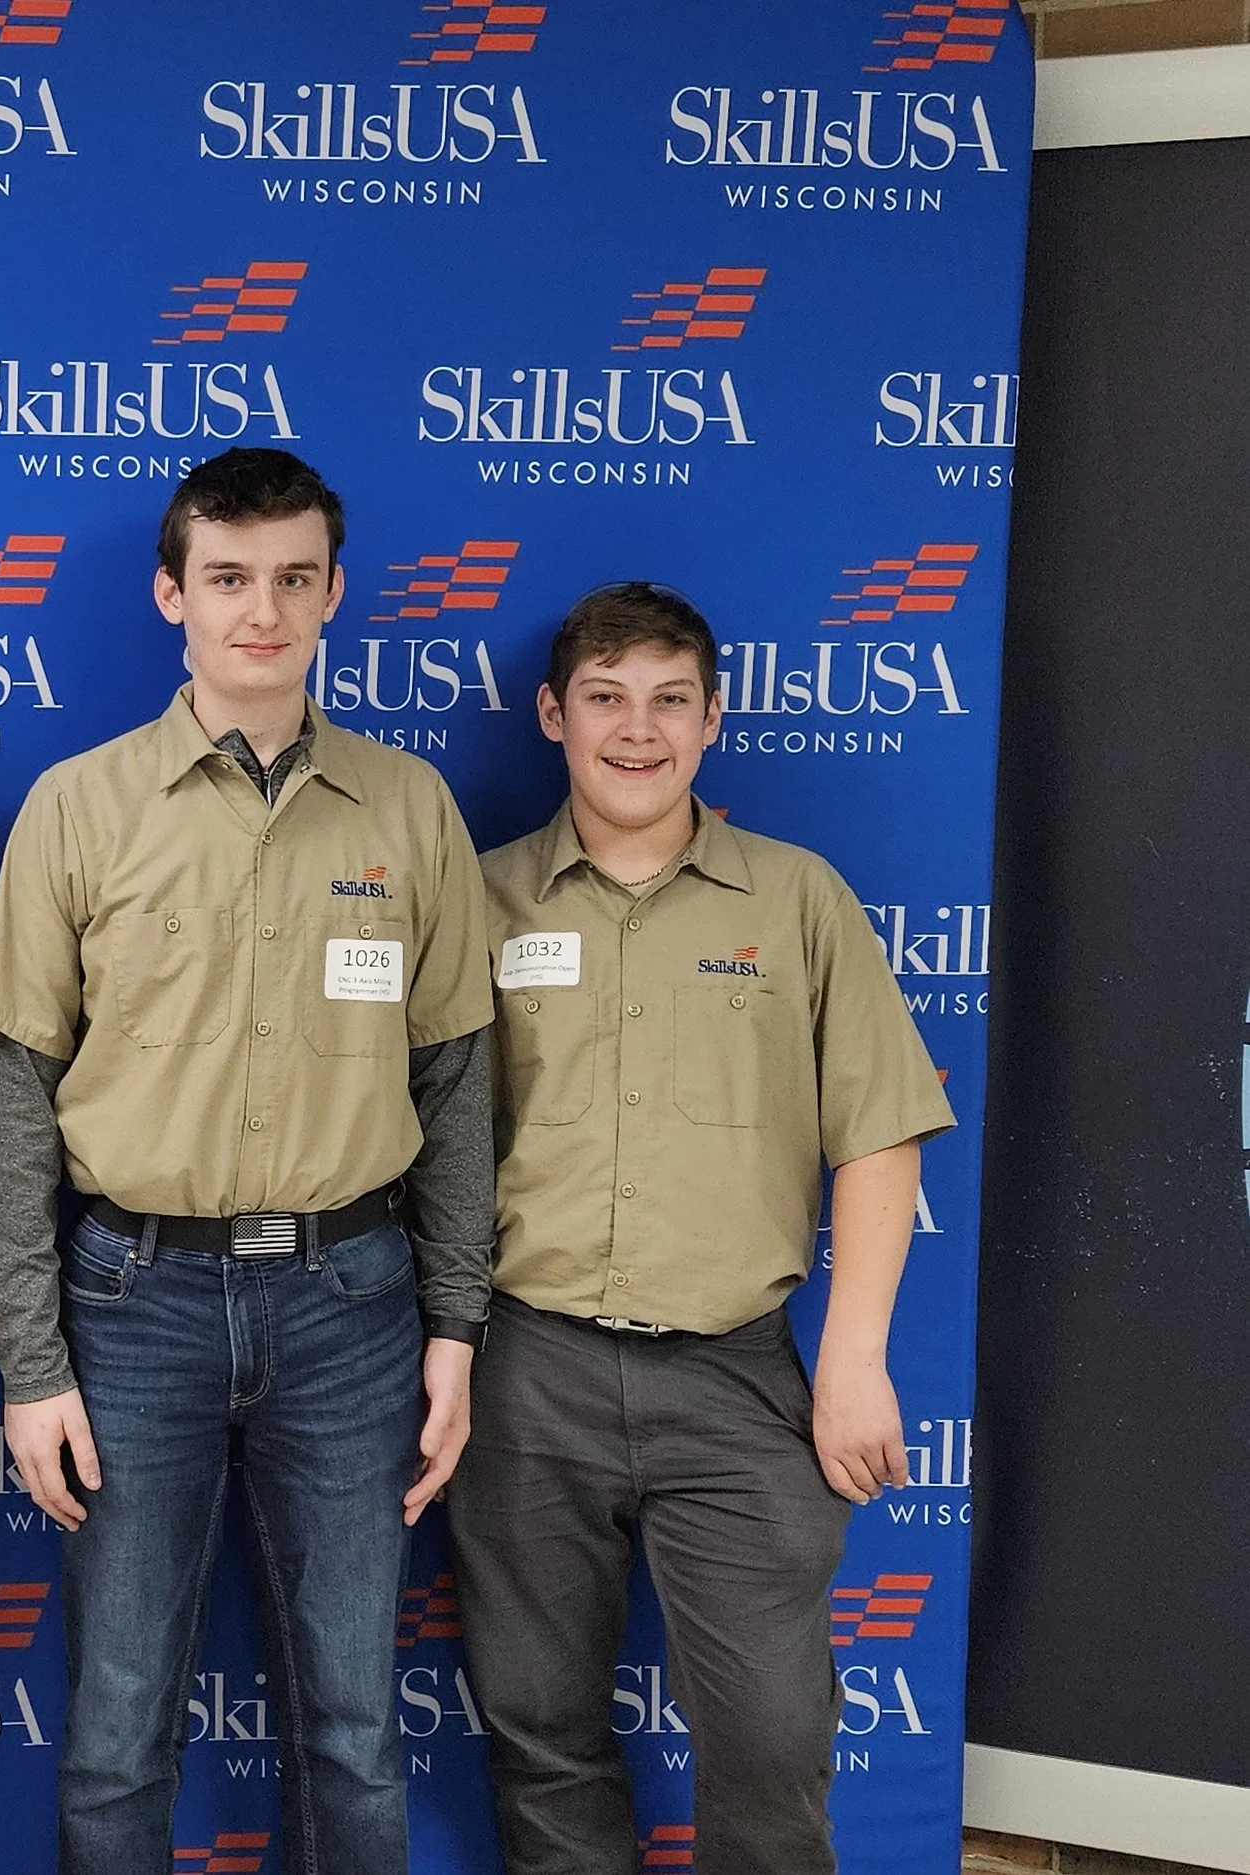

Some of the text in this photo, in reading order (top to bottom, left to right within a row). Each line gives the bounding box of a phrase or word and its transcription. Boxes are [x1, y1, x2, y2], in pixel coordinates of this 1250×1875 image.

[200, 81, 547, 163] SkillsUSA
[666, 86, 1007, 172] SkillsUSA
[264, 179, 481, 204] WISCONSIN
[726, 185, 941, 211] WISCONSIN
[419, 366, 755, 445] SkillsUSA
[20, 454, 207, 479] WISCONS
[478, 461, 690, 485] WISCONSIN
[315, 638, 510, 711] lsUSA
[716, 642, 970, 714] illsUSA
[721, 731, 902, 753] ISCONSIN
[331, 880, 386, 899] SkillsUSA
[343, 948, 391, 969] 1026
[517, 941, 563, 960] 1032
[698, 959, 759, 978] SkillsUSA
